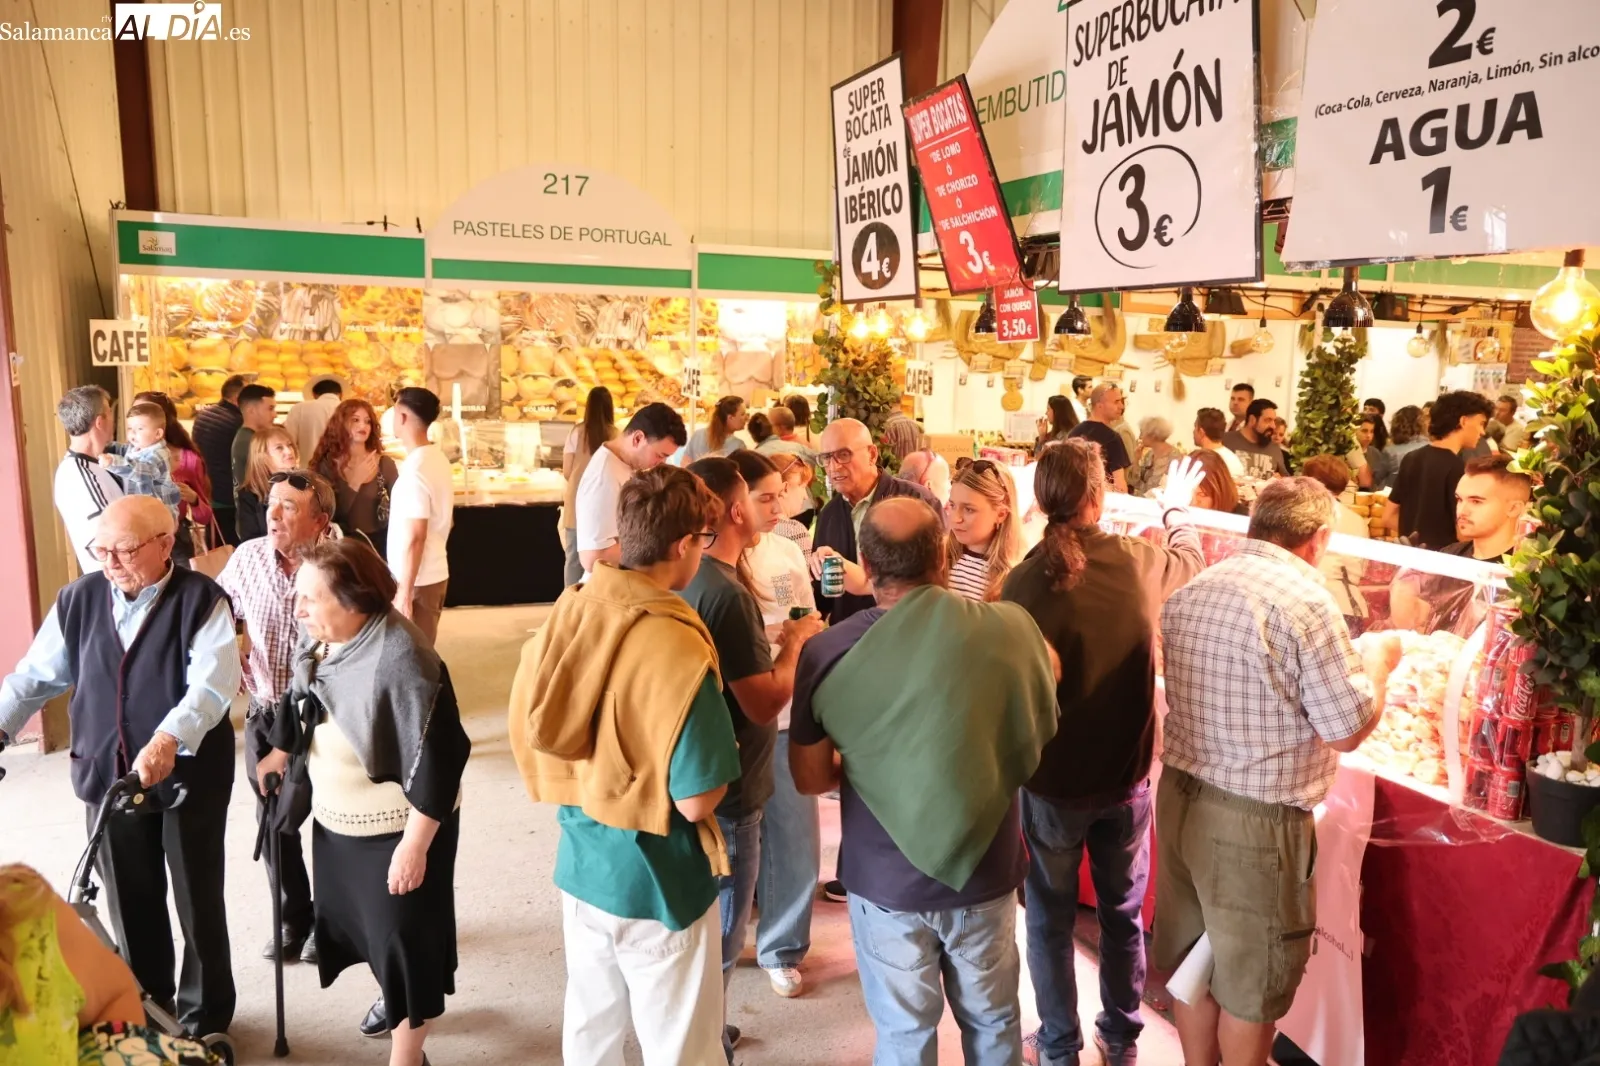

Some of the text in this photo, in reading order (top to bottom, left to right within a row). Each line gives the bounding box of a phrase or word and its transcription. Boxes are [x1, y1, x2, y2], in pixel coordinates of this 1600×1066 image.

[1073, 0, 1240, 67] SUPERBOC
[1107, 55, 1129, 91] DE
[1314, 95, 1374, 119] (Coca-Cola,
[1375, 85, 1425, 105] Cerveza,
[1427, 71, 1483, 94] Naranja,
[1486, 59, 1535, 82] Limón,
[1538, 52, 1563, 70] Sin
[847, 77, 886, 116] SUPER
[1081, 48, 1223, 155] JAMÓN
[845, 103, 893, 143] BOCATA
[909, 91, 968, 145] SUPER BOCATAS
[1369, 90, 1544, 166] AGUA
[844, 138, 898, 187] JAMÓN
[941, 141, 962, 160] LOMO
[542, 173, 590, 196] 217
[844, 182, 903, 225] IBÉRICO
[946, 173, 979, 194] CHORIZO
[452, 220, 673, 246] PASTELES DE PORTUGAL
[950, 205, 998, 229] SALCHICHÓN
[999, 300, 1033, 314] CON QUESO
[92, 323, 149, 363] CAFÉ
